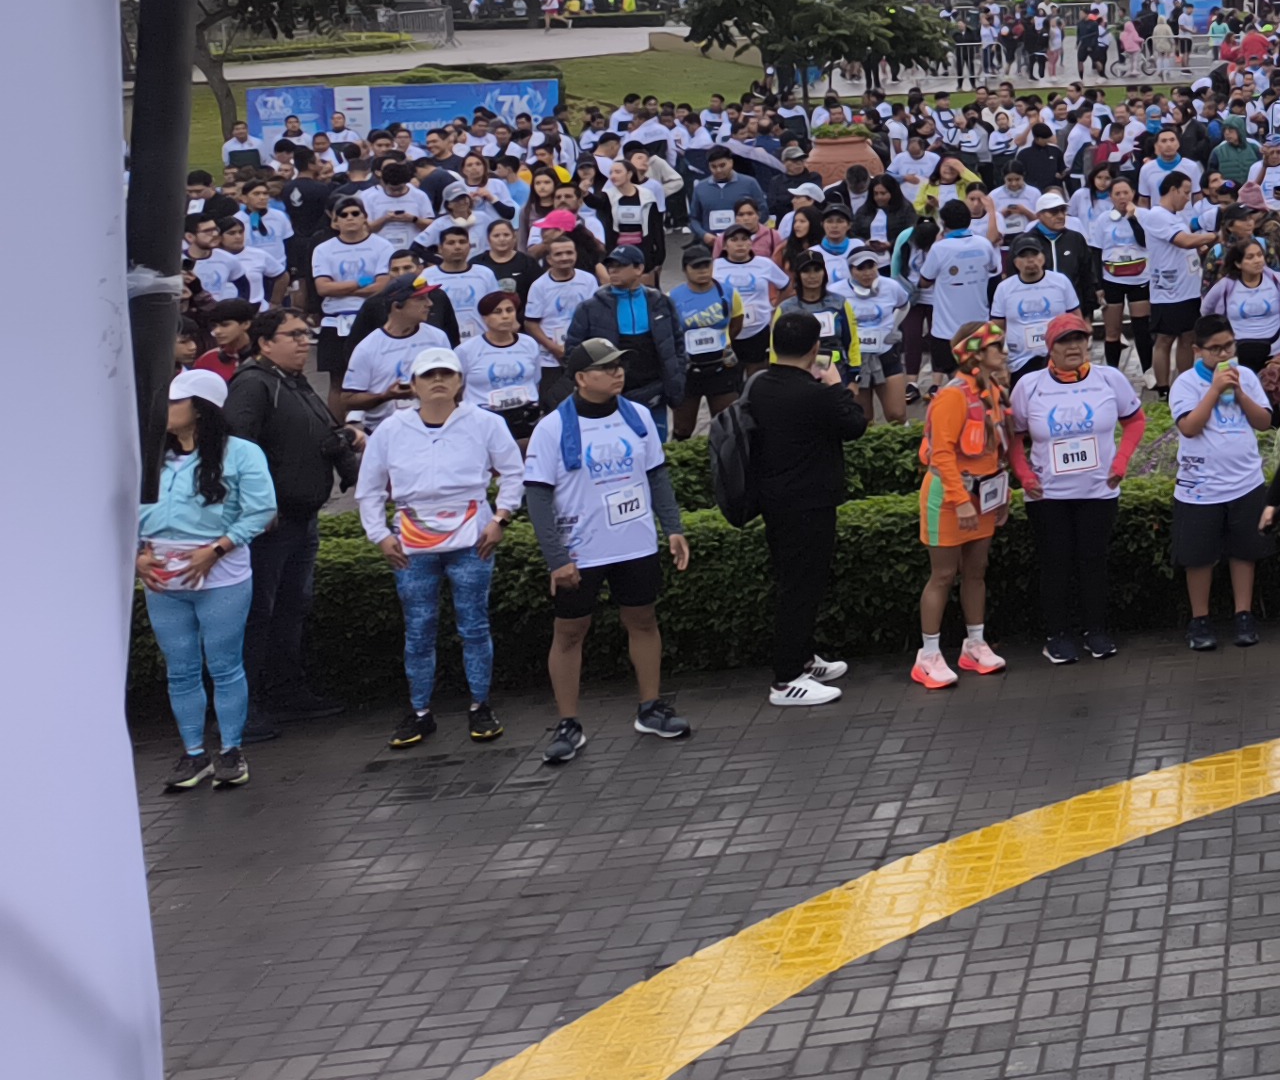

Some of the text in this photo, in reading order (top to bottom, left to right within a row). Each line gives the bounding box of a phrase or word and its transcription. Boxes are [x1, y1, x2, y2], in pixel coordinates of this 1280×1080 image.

[497, 94, 531, 115] 7K
[1062, 450, 1088, 464] 8118
[617, 498, 641, 516] 1723
